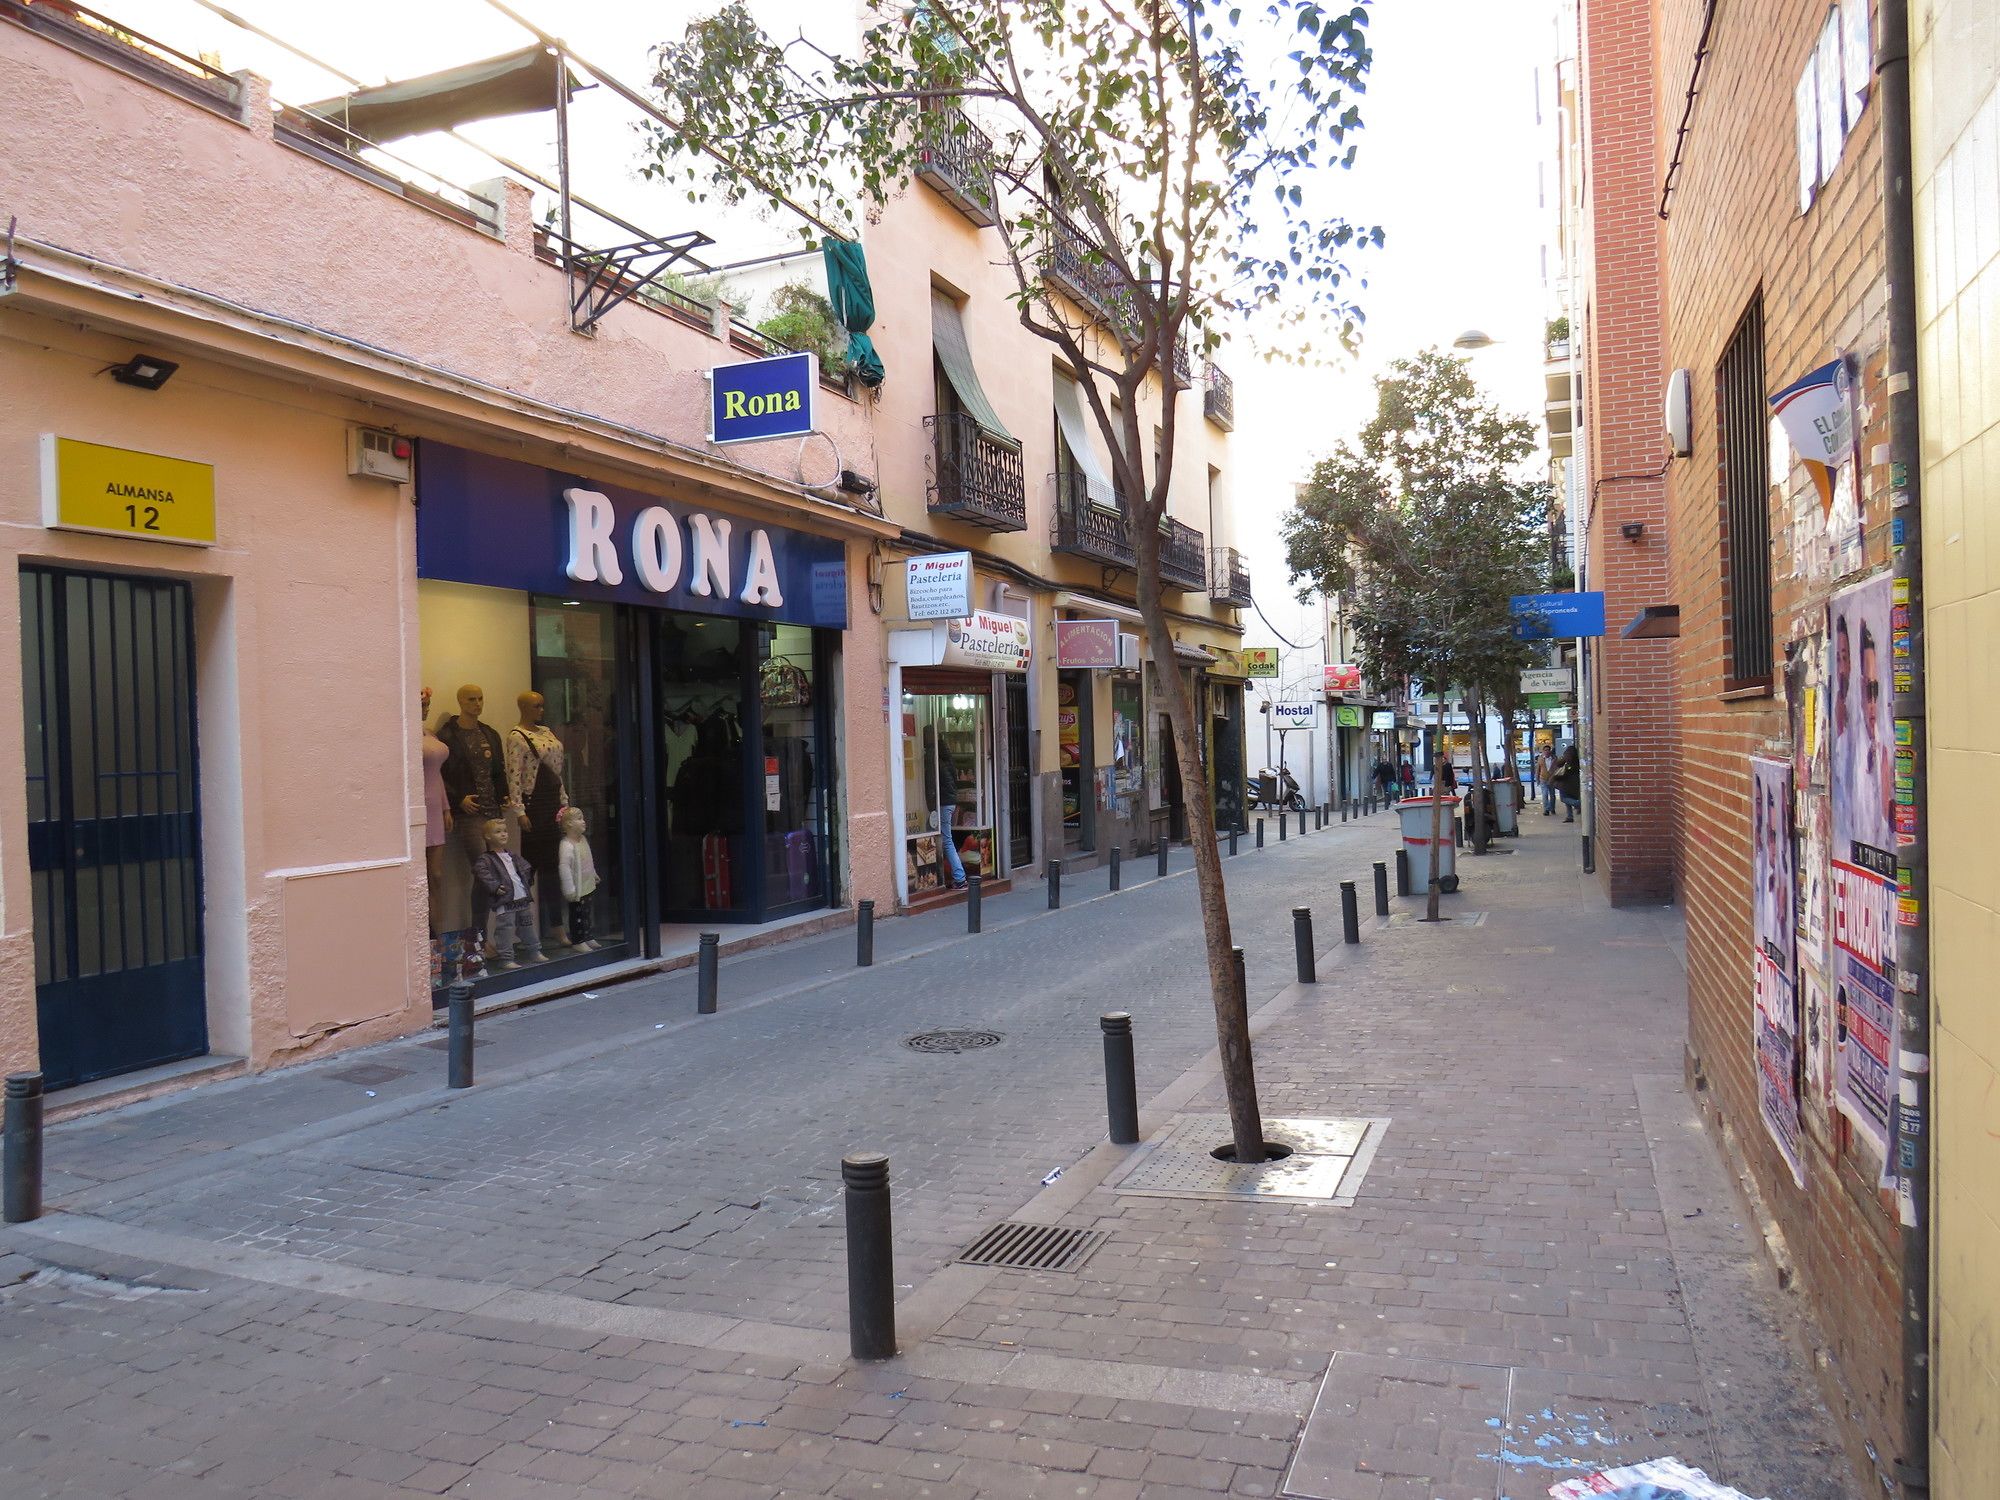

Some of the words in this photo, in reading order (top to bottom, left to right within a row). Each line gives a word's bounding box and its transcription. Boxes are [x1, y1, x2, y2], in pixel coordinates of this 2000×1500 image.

[723, 390, 801, 420] Rona
[106, 482, 175, 504] ALMANSA
[126, 504, 160, 530] 12
[563, 487, 784, 607] RONA
[925, 560, 963, 571] Miguel
[978, 615, 1013, 635] Miguel
[960, 633, 1019, 656] Pastelería
[1090, 656, 1114, 664] Secos
[1247, 662, 1276, 670] Kodak
[1521, 671, 1553, 680] Agencia
[1530, 680, 1540, 688] de
[1541, 680, 1567, 688] Viajes
[1275, 704, 1313, 716] Hostal
